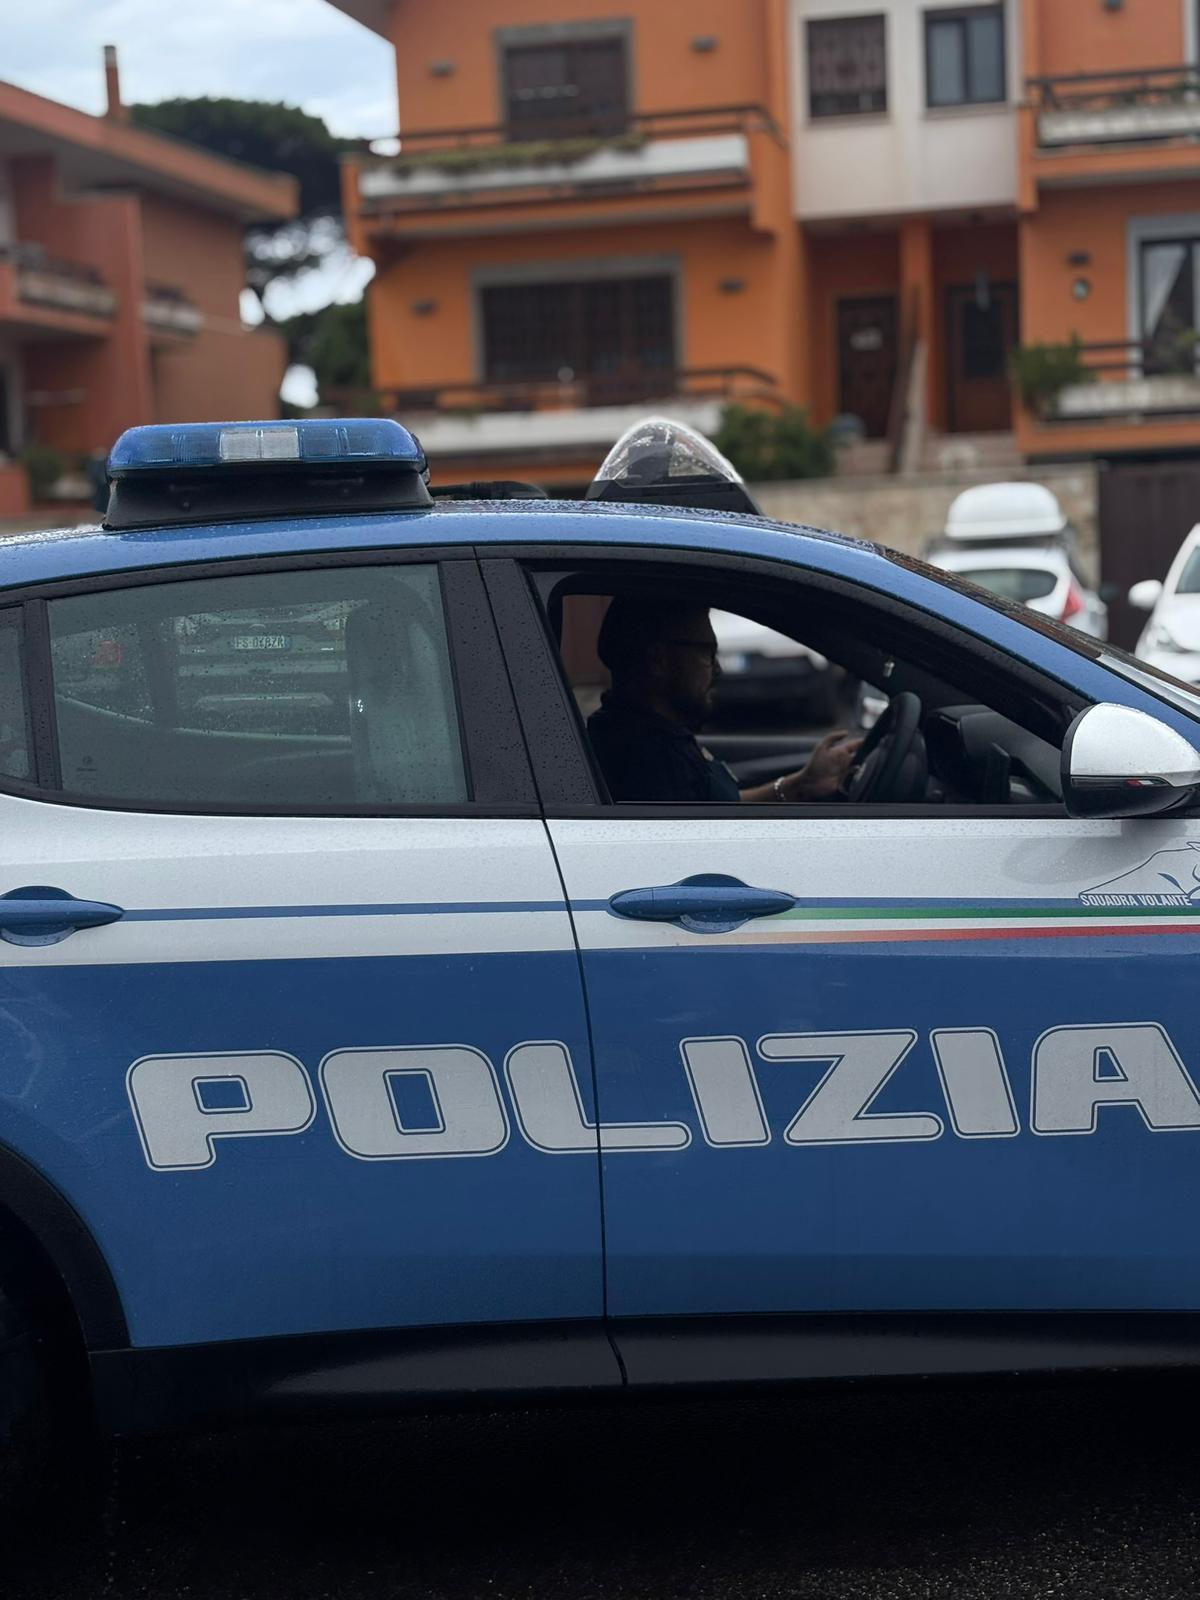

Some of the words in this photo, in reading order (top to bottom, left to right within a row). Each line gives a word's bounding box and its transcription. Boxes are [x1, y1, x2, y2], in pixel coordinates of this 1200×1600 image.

[1080, 894, 1139, 906] SQUADRA
[1139, 894, 1193, 906] VOLANTE
[125, 1021, 1200, 1172] POLIZIA
